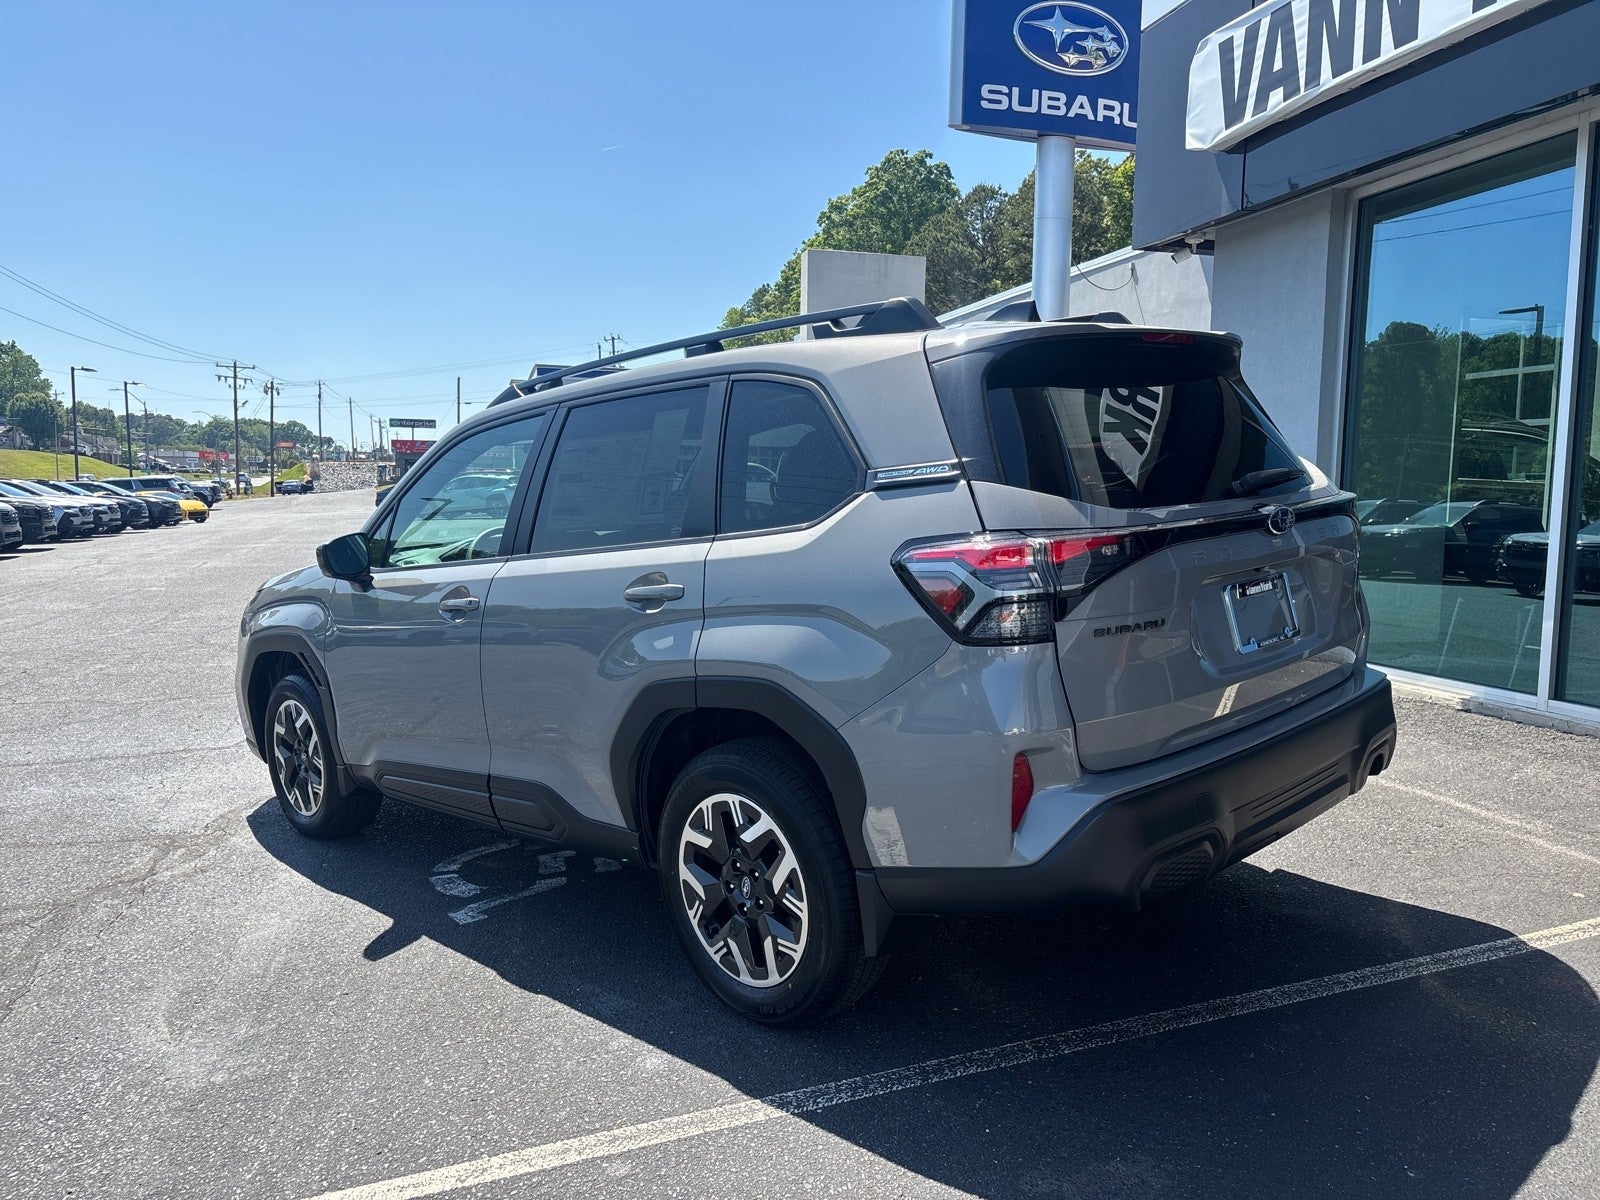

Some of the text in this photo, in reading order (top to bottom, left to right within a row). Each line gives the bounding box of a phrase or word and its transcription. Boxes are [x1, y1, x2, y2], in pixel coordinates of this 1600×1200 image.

[1218, 0, 1420, 131] VANN
[913, 465, 949, 475] AWD
[1093, 618, 1166, 638] SUBARU
